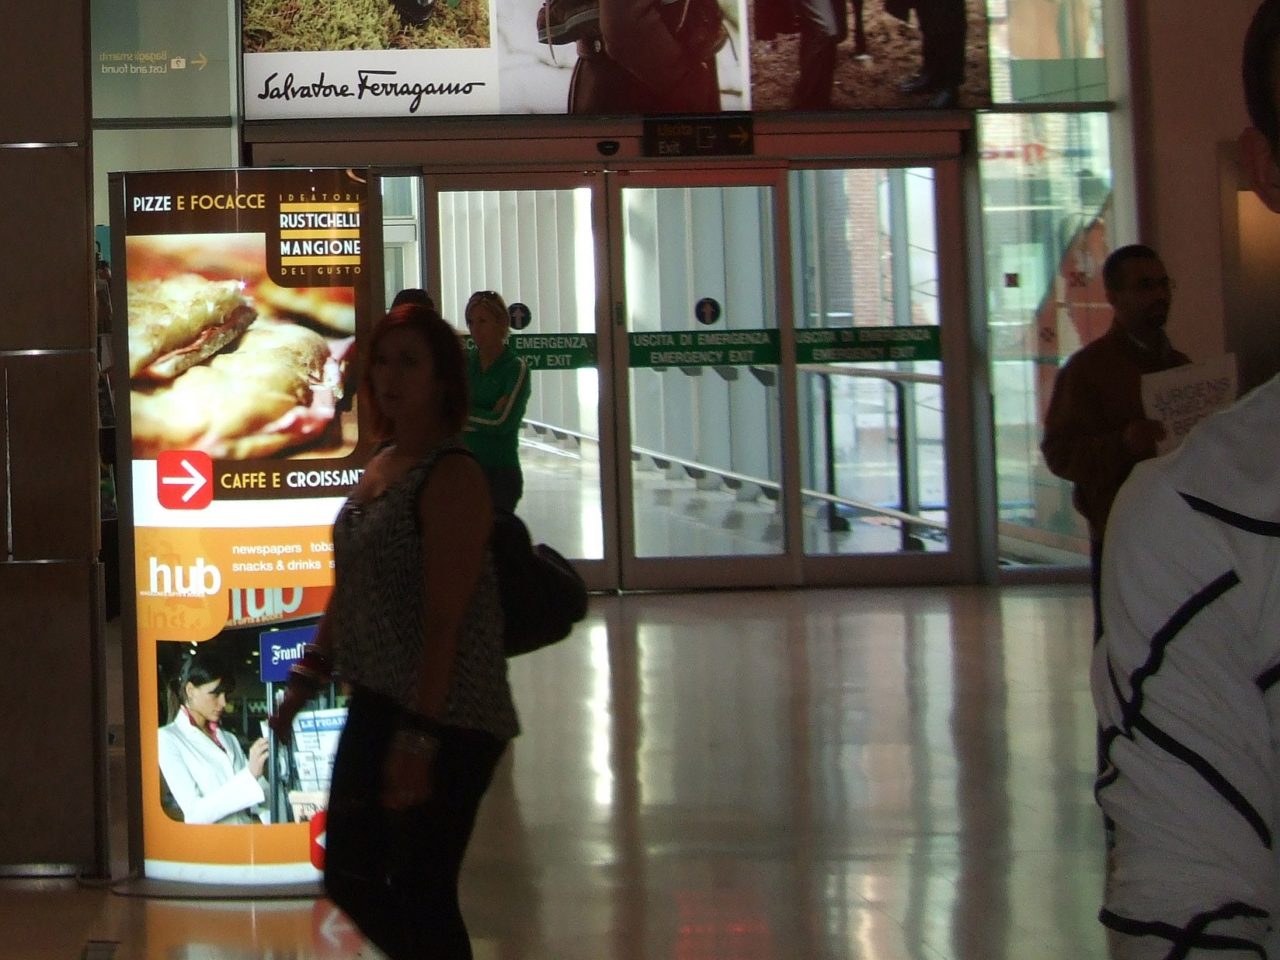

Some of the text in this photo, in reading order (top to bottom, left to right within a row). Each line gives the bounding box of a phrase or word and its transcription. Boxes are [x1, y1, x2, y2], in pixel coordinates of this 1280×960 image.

[257, 70, 486, 114] Salvatore Ferragamo
[133, 194, 265, 212] PIZZE E FOCACCE
[280, 213, 360, 228] RUSTICHELLI
[280, 240, 361, 255] MANGIONE
[281, 266, 361, 275] DEL GUSTO
[516, 336, 589, 350] EMERGENZA
[633, 332, 771, 346] USCITA DI EMERGENZA
[547, 354, 573, 367] EXIT
[649, 349, 755, 364] EMERGENCY EXIT
[272, 472, 281, 488] E
[232, 544, 302, 556] newspapers
[232, 561, 274, 572] snacks
[276, 560, 285, 572] &
[287, 559, 322, 571] drinks
[149, 556, 222, 595] hub
